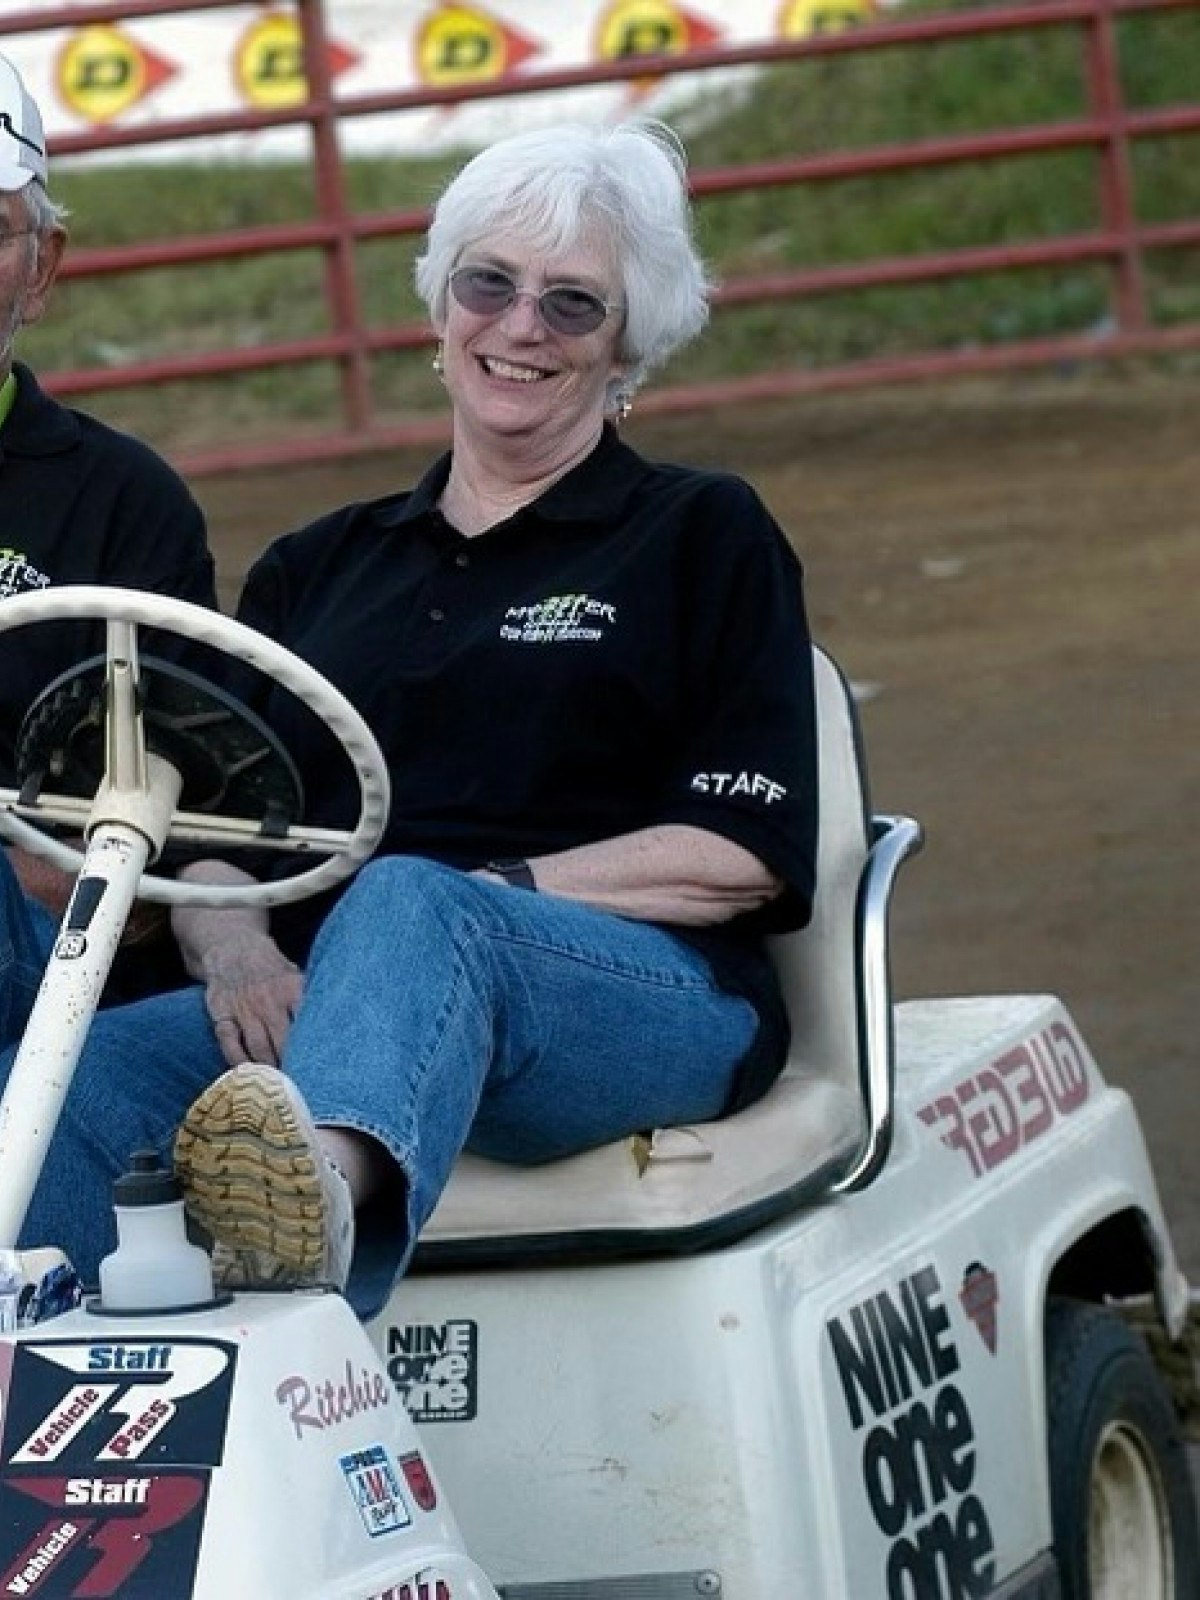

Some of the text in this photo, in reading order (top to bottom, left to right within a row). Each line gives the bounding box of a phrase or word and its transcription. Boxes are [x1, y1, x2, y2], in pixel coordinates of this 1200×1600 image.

[76, 55, 131, 90] D
[691, 772, 787, 804] STAFF
[87, 1346, 172, 1371] Staff
[388, 1323, 470, 1354] NINE
[826, 1265, 959, 1429] NINE
[387, 1355, 468, 1382] one
[28, 1388, 100, 1457] Vehicle
[275, 1359, 389, 1441] Ritchie
[109, 1399, 169, 1457] Pass
[863, 1384, 977, 1537] one
[64, 1478, 151, 1506] Staff
[6, 1522, 78, 1595] Vehicle
